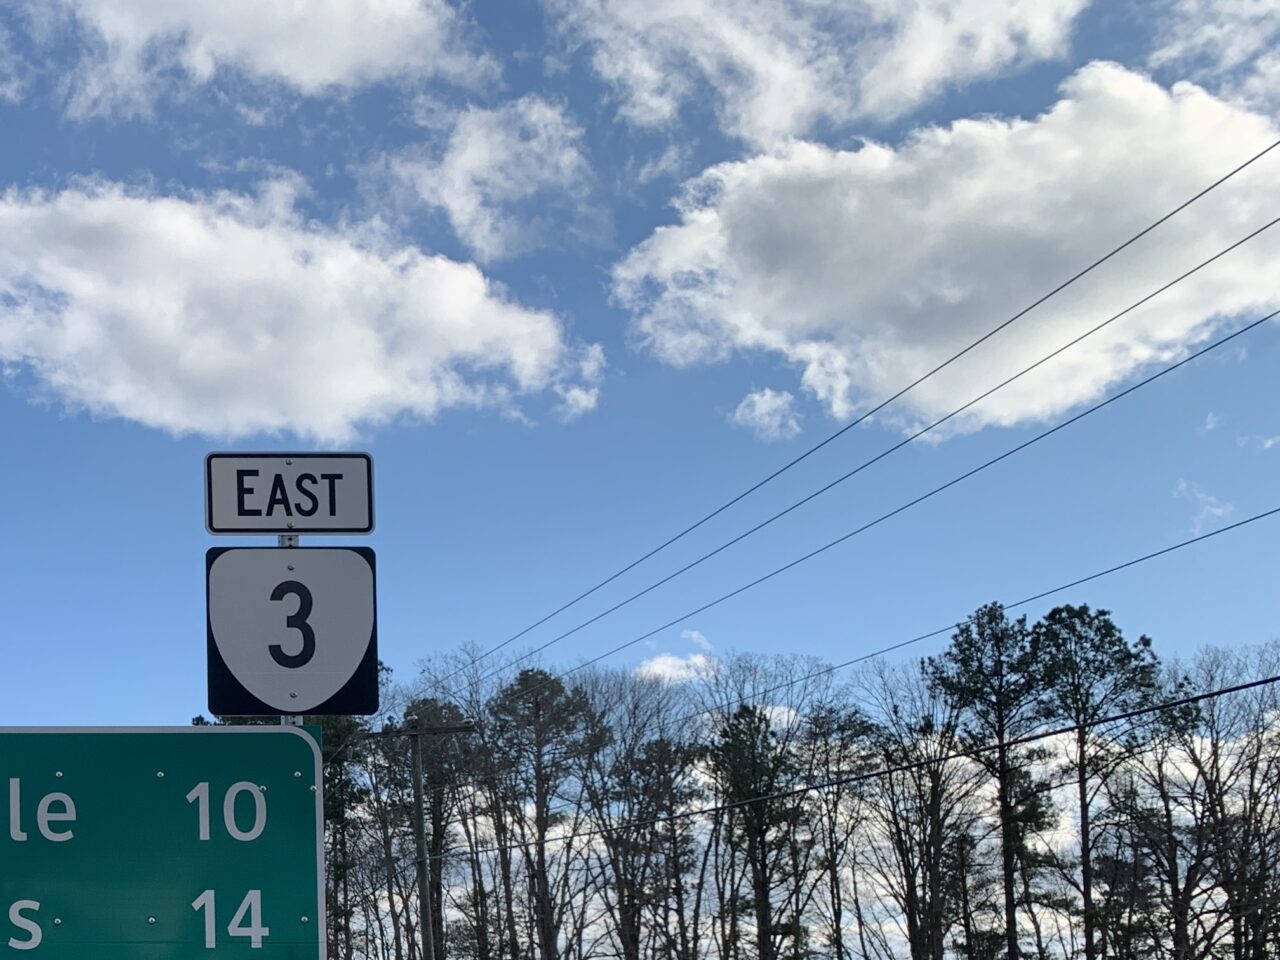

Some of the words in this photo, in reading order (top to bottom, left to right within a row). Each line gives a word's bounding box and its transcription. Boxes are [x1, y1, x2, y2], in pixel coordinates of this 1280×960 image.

[237, 469, 343, 516] EAST
[268, 580, 316, 668] 3
[186, 781, 267, 841] 10
[192, 889, 269, 949] 14
